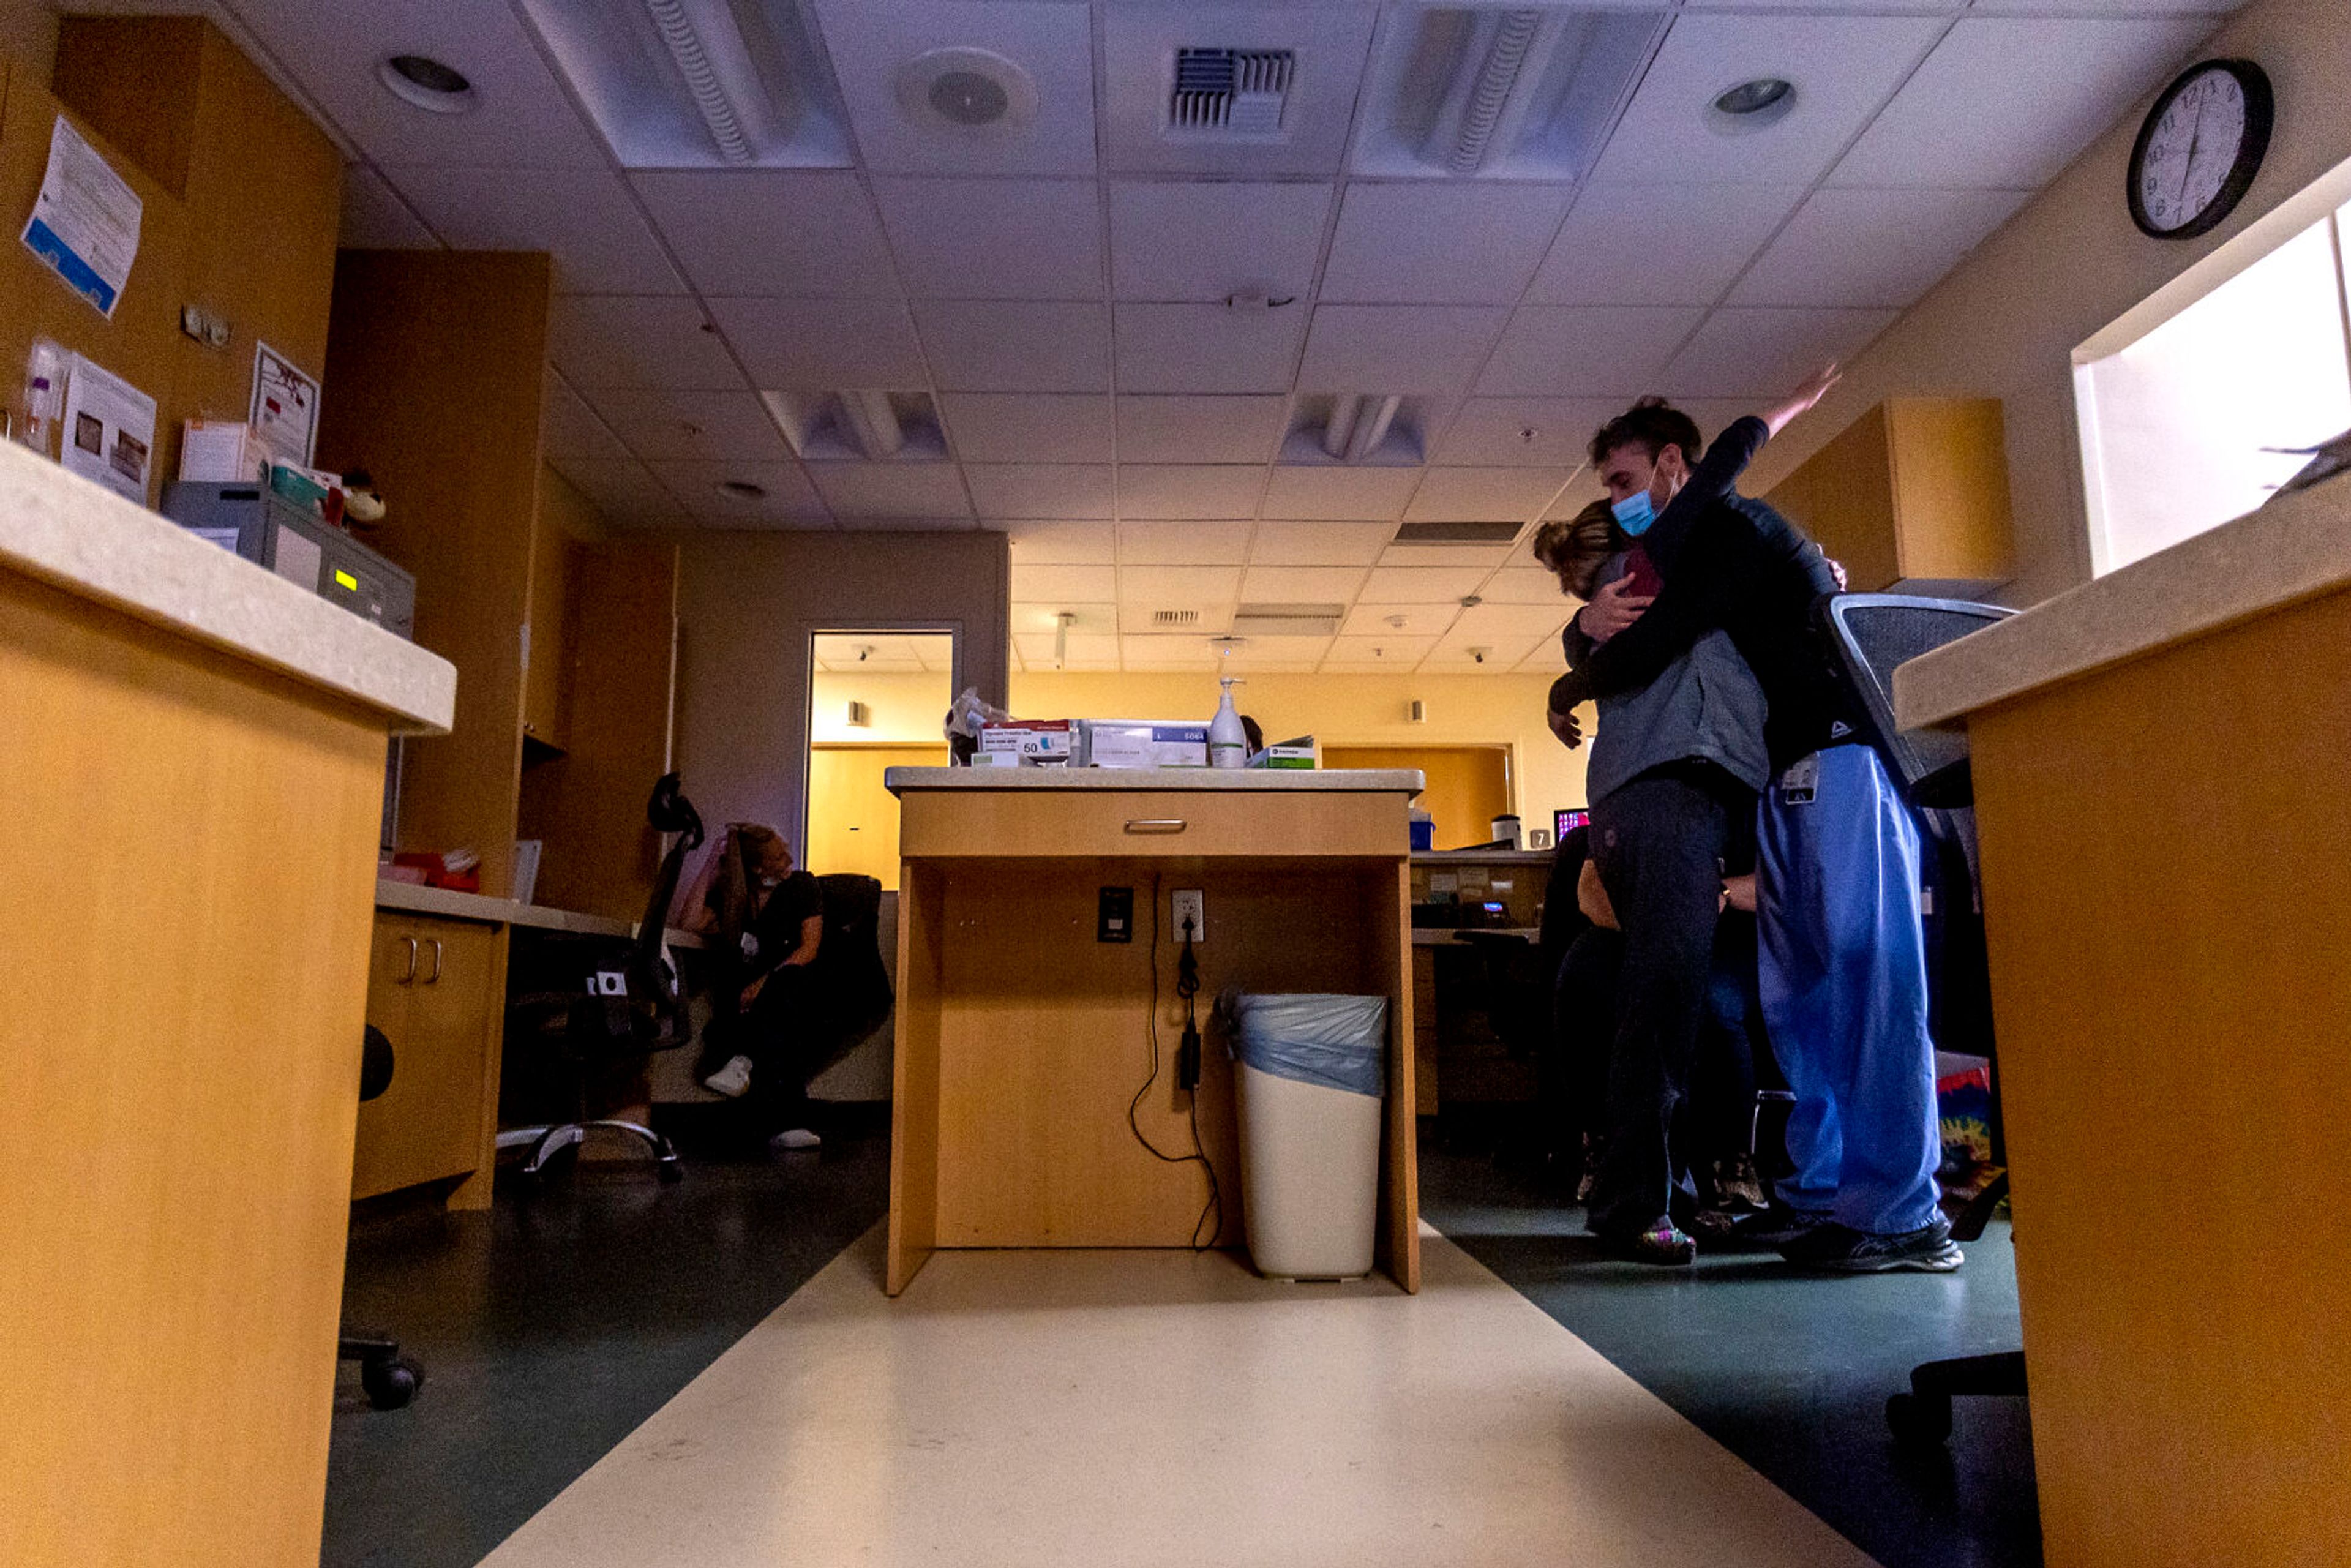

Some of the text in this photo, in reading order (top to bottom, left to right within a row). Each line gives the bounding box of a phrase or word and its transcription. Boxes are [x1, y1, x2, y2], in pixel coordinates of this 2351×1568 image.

[2182, 86, 2197, 109] 12
[2227, 83, 2238, 103] 2
[2163, 114, 2175, 133] 11
[2148, 144, 2164, 167] 10
[2147, 177, 2157, 195] 9
[1024, 743, 1037, 753] 50
[1538, 833, 1544, 845] 7
